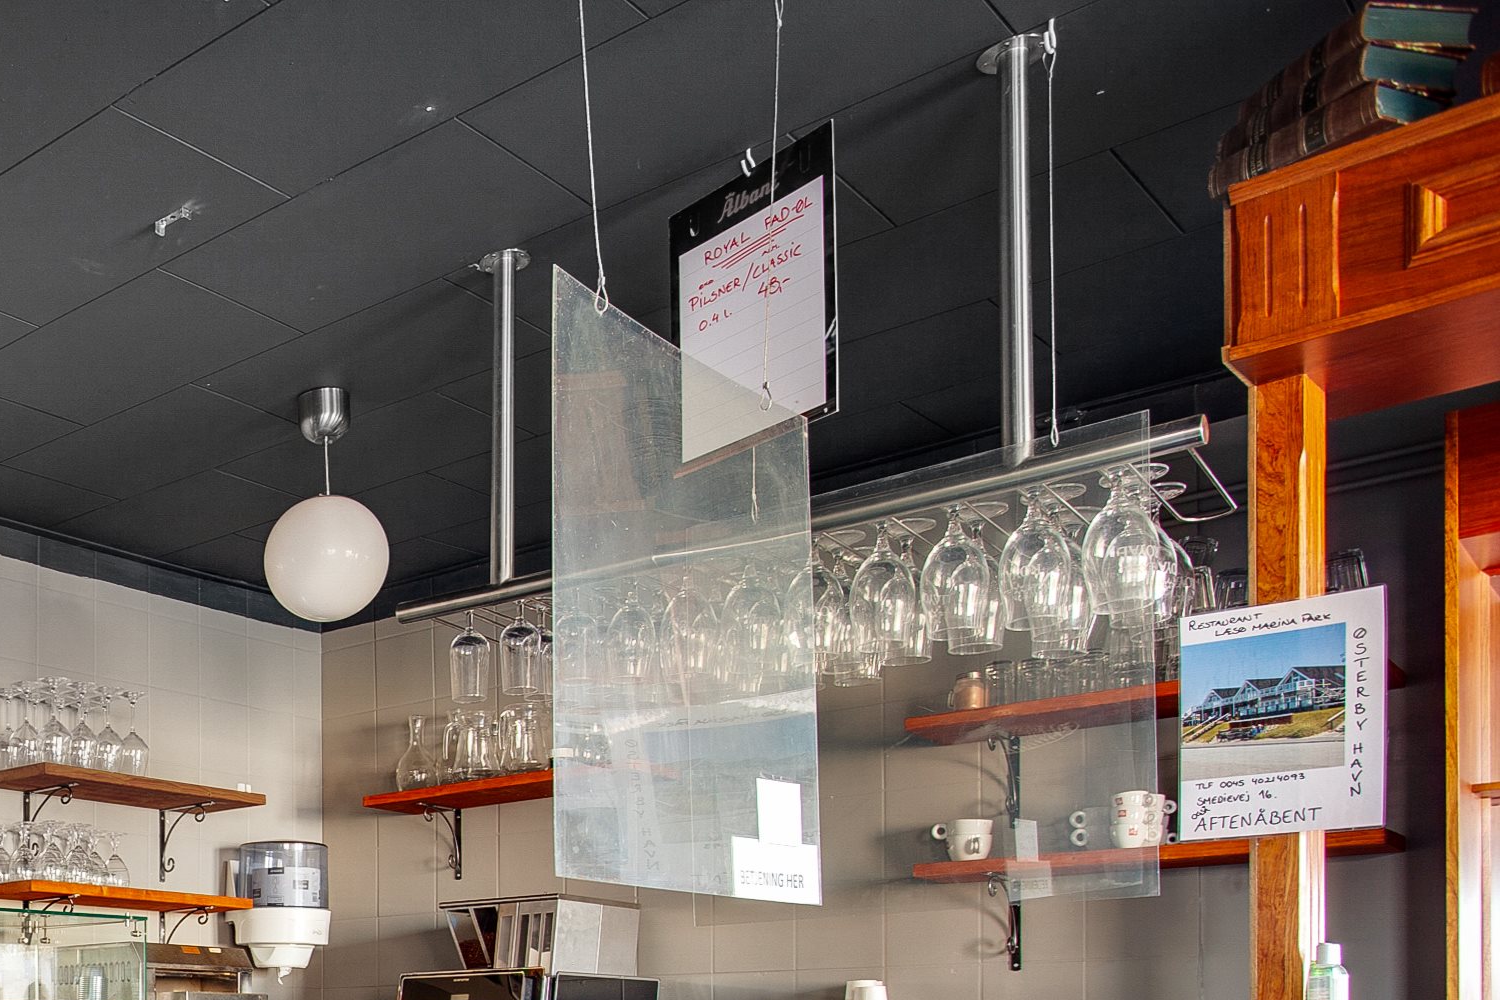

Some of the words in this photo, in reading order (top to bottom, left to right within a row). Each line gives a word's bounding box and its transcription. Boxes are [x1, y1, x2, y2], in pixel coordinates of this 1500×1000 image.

[704, 232, 750, 265] ROYAL
[1189, 612, 1263, 632] RESTAURANT
[1301, 612, 1332, 623] PARK
[1349, 743, 1364, 797] HAVN
[1219, 779, 1245, 789] 0045
[786, 874, 805, 889] HER
